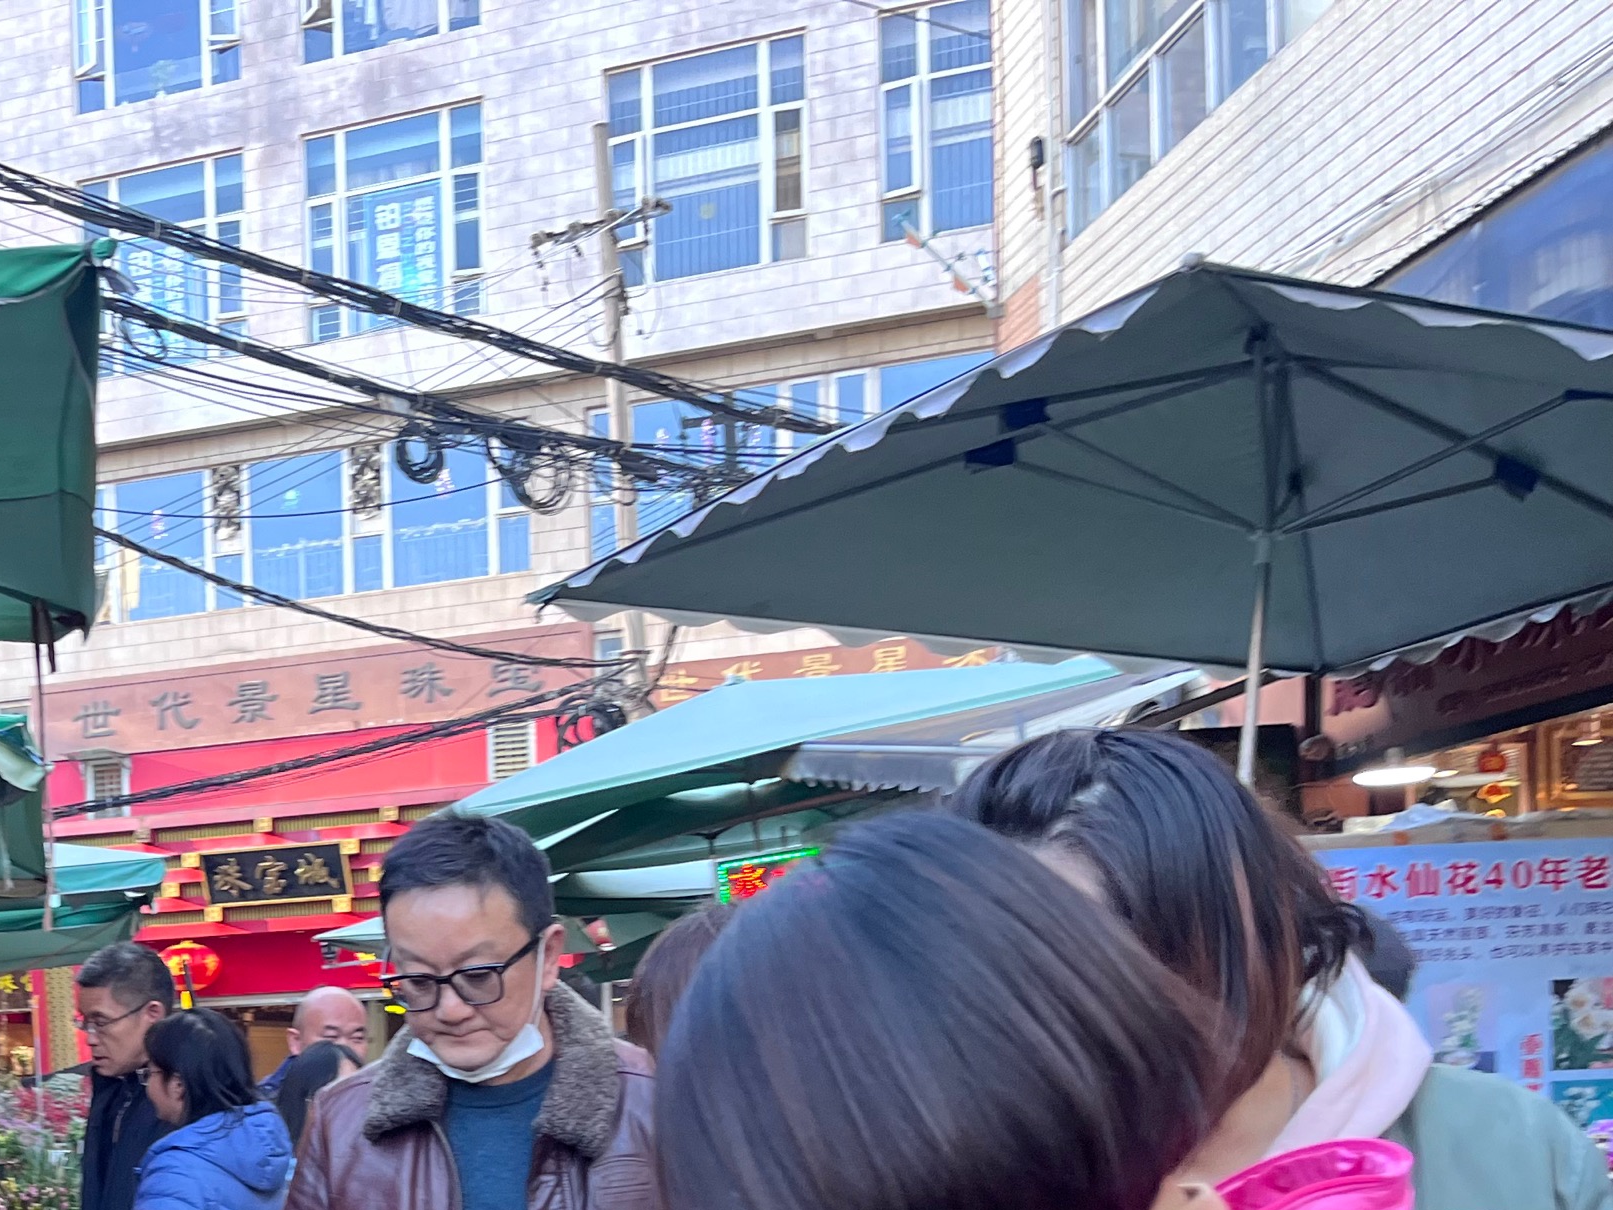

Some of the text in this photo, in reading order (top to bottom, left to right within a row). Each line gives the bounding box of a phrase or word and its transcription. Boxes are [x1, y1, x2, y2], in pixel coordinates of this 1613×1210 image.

[72, 662, 545, 739] 世代景星珠宝
[213, 853, 340, 896] 珠宝城
